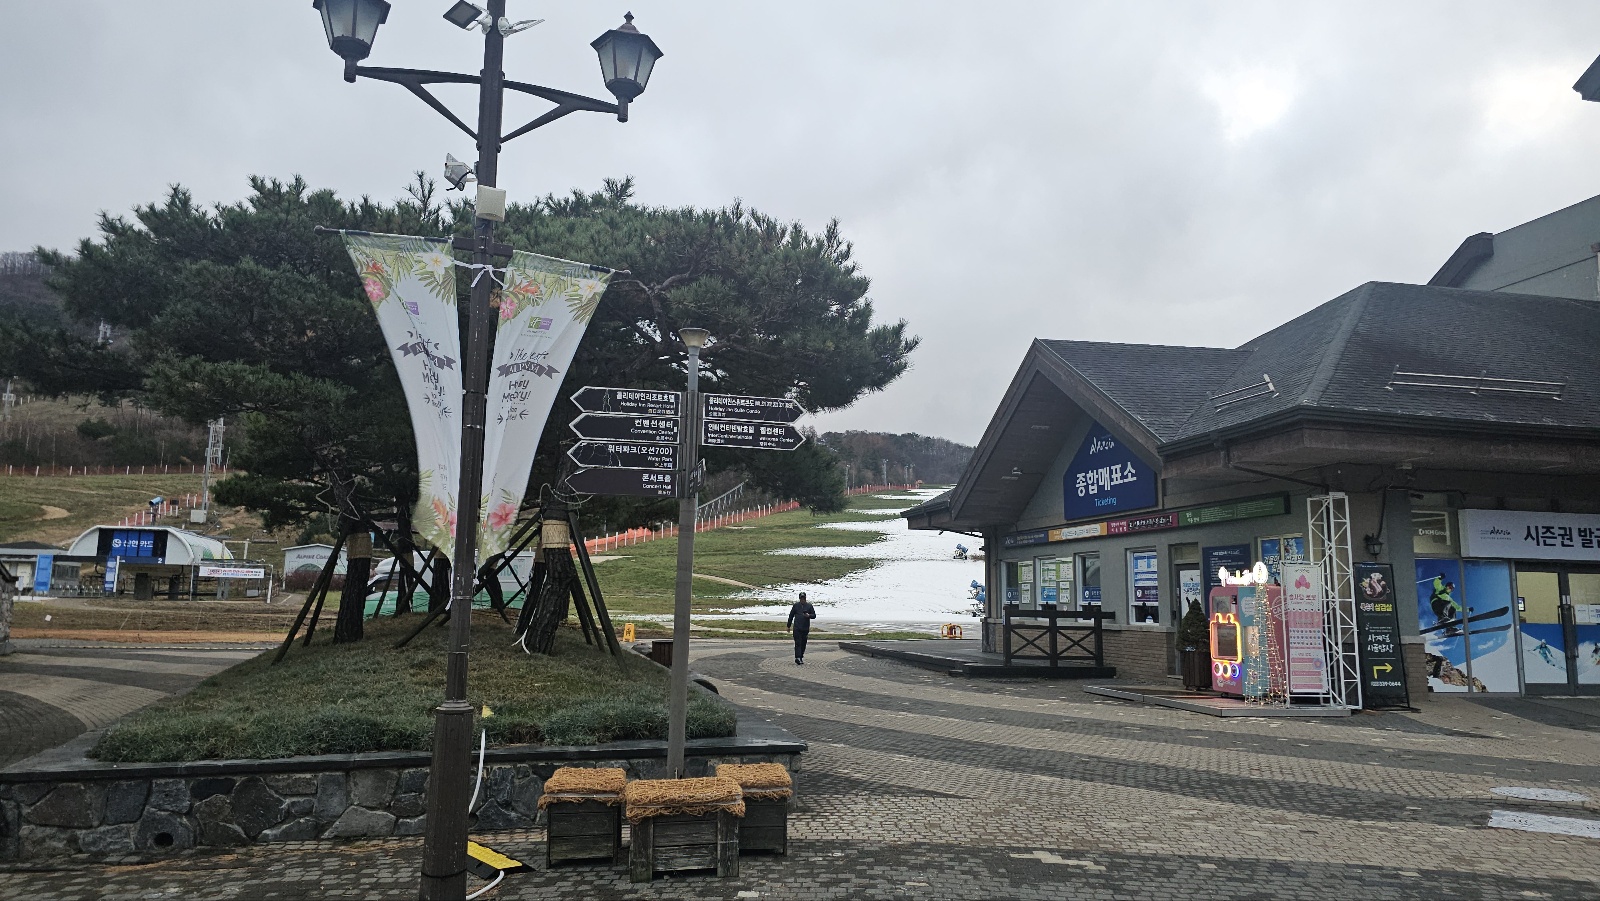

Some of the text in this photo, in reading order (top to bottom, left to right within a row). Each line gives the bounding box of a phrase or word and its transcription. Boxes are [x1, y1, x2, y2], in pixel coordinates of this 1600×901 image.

[634, 419, 673, 429] 컨벤션센터
[607, 444, 673, 456] 워터파크(오션700)
[642, 473, 672, 483] 콘서트홀
[1075, 461, 1137, 497] 종합매표소
[1094, 496, 1117, 507] Ticketing
[1523, 525, 1575, 548] 시즌권
